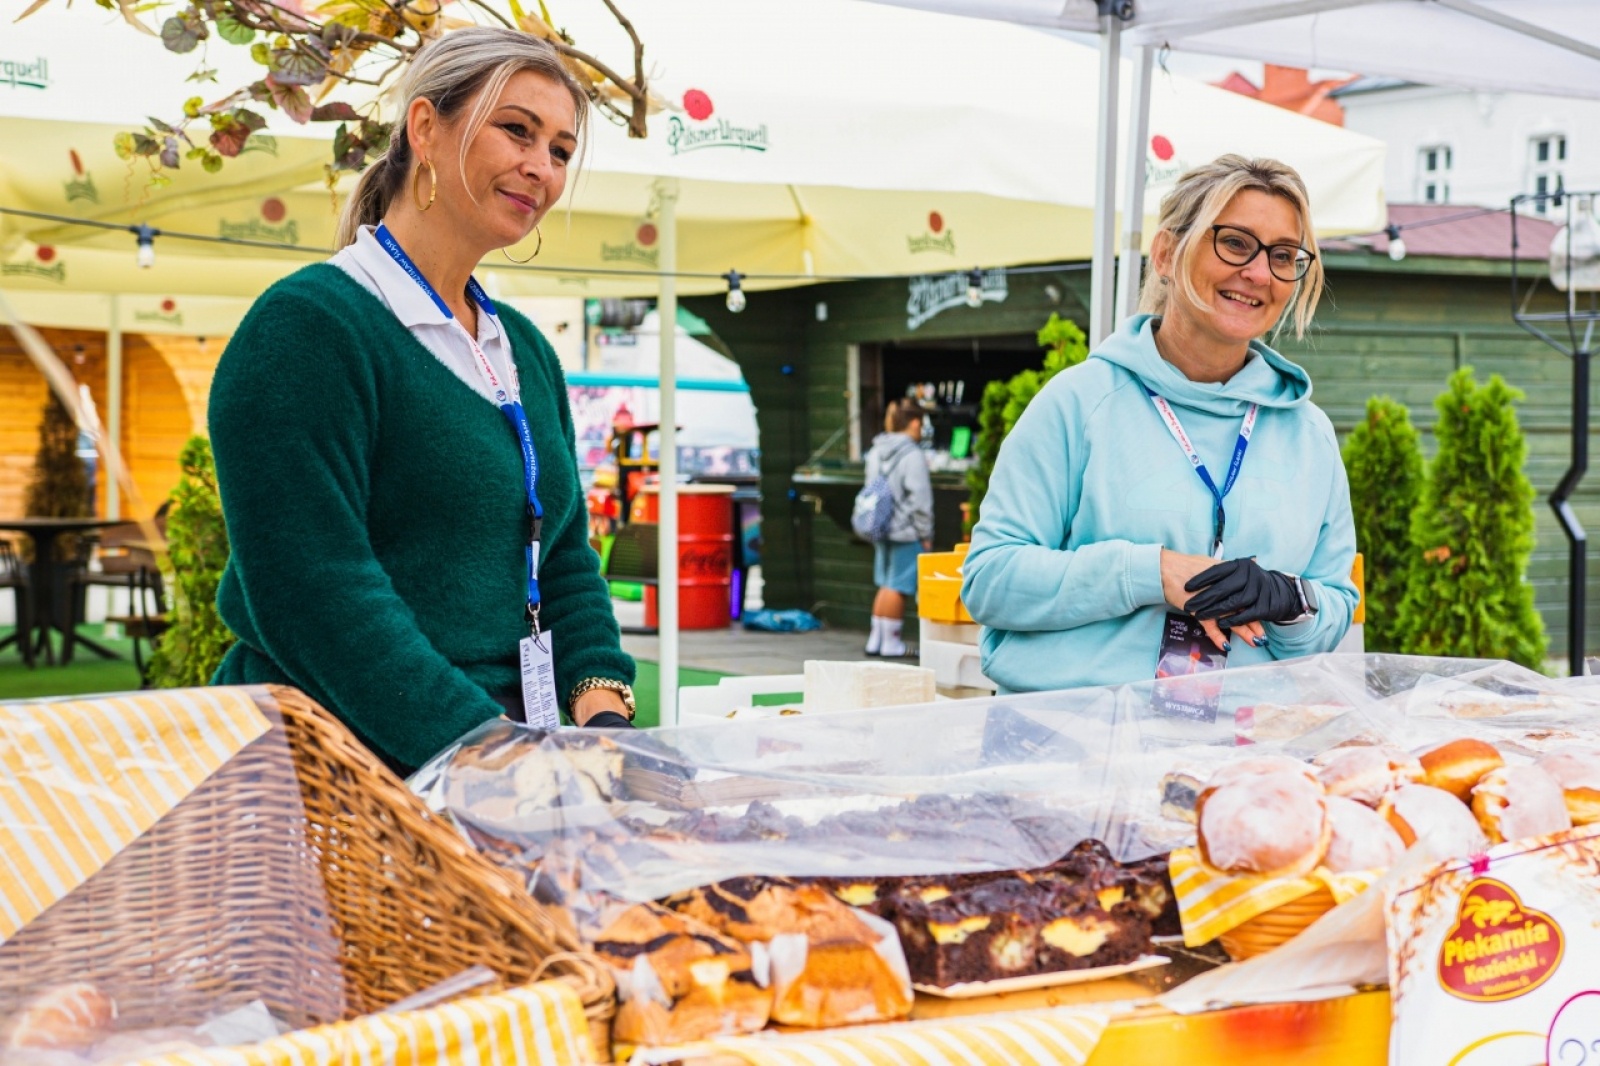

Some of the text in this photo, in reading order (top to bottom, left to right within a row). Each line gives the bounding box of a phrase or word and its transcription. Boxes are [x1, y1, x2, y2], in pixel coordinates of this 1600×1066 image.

[667, 116, 768, 156] Pilsner Urquell
[1444, 920, 1550, 967] Piekarnia
[1464, 950, 1538, 985] Kozielski
